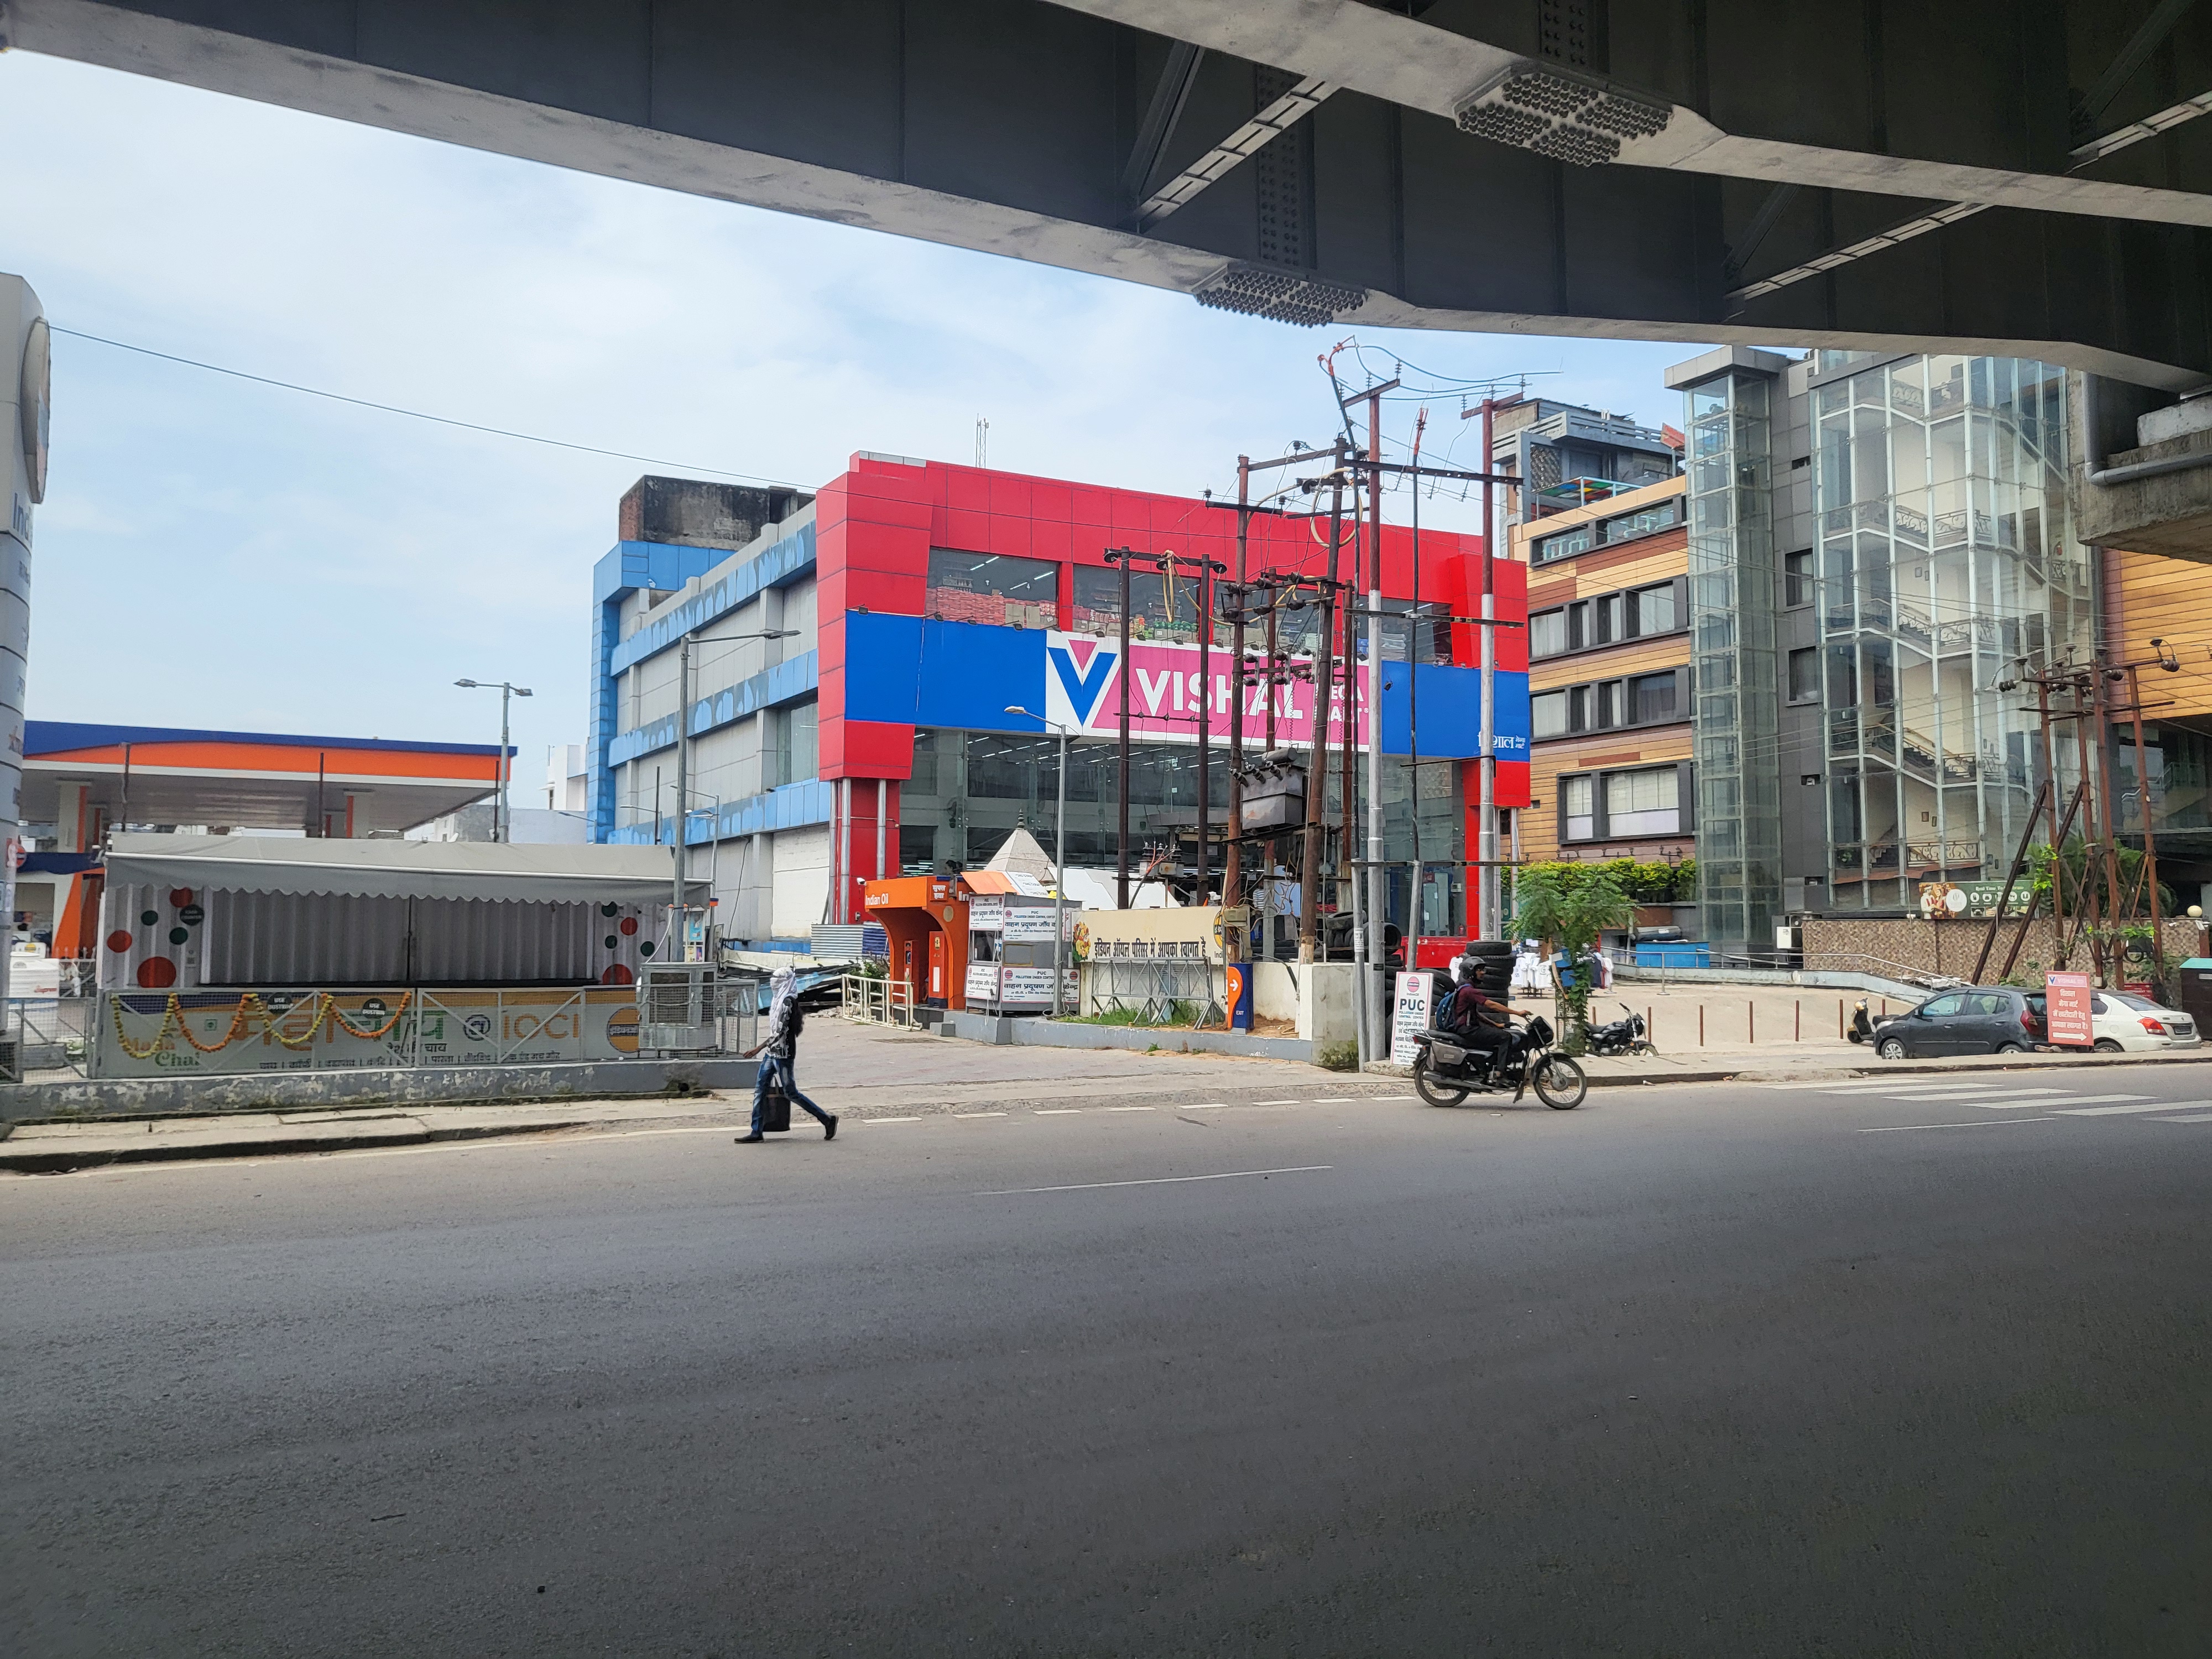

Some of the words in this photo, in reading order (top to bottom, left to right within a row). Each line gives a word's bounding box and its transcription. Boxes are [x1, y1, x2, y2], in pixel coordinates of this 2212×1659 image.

[1135, 668, 1303, 719] VISHAL
[865, 894, 880, 906] Indian
[1158, 941, 1178, 957] आपका
[1200, 936, 1206, 957] है
[1400, 998, 1425, 1011] PUC
[425, 1043, 447, 1052] चाय
[155, 1051, 200, 1067] Chai
